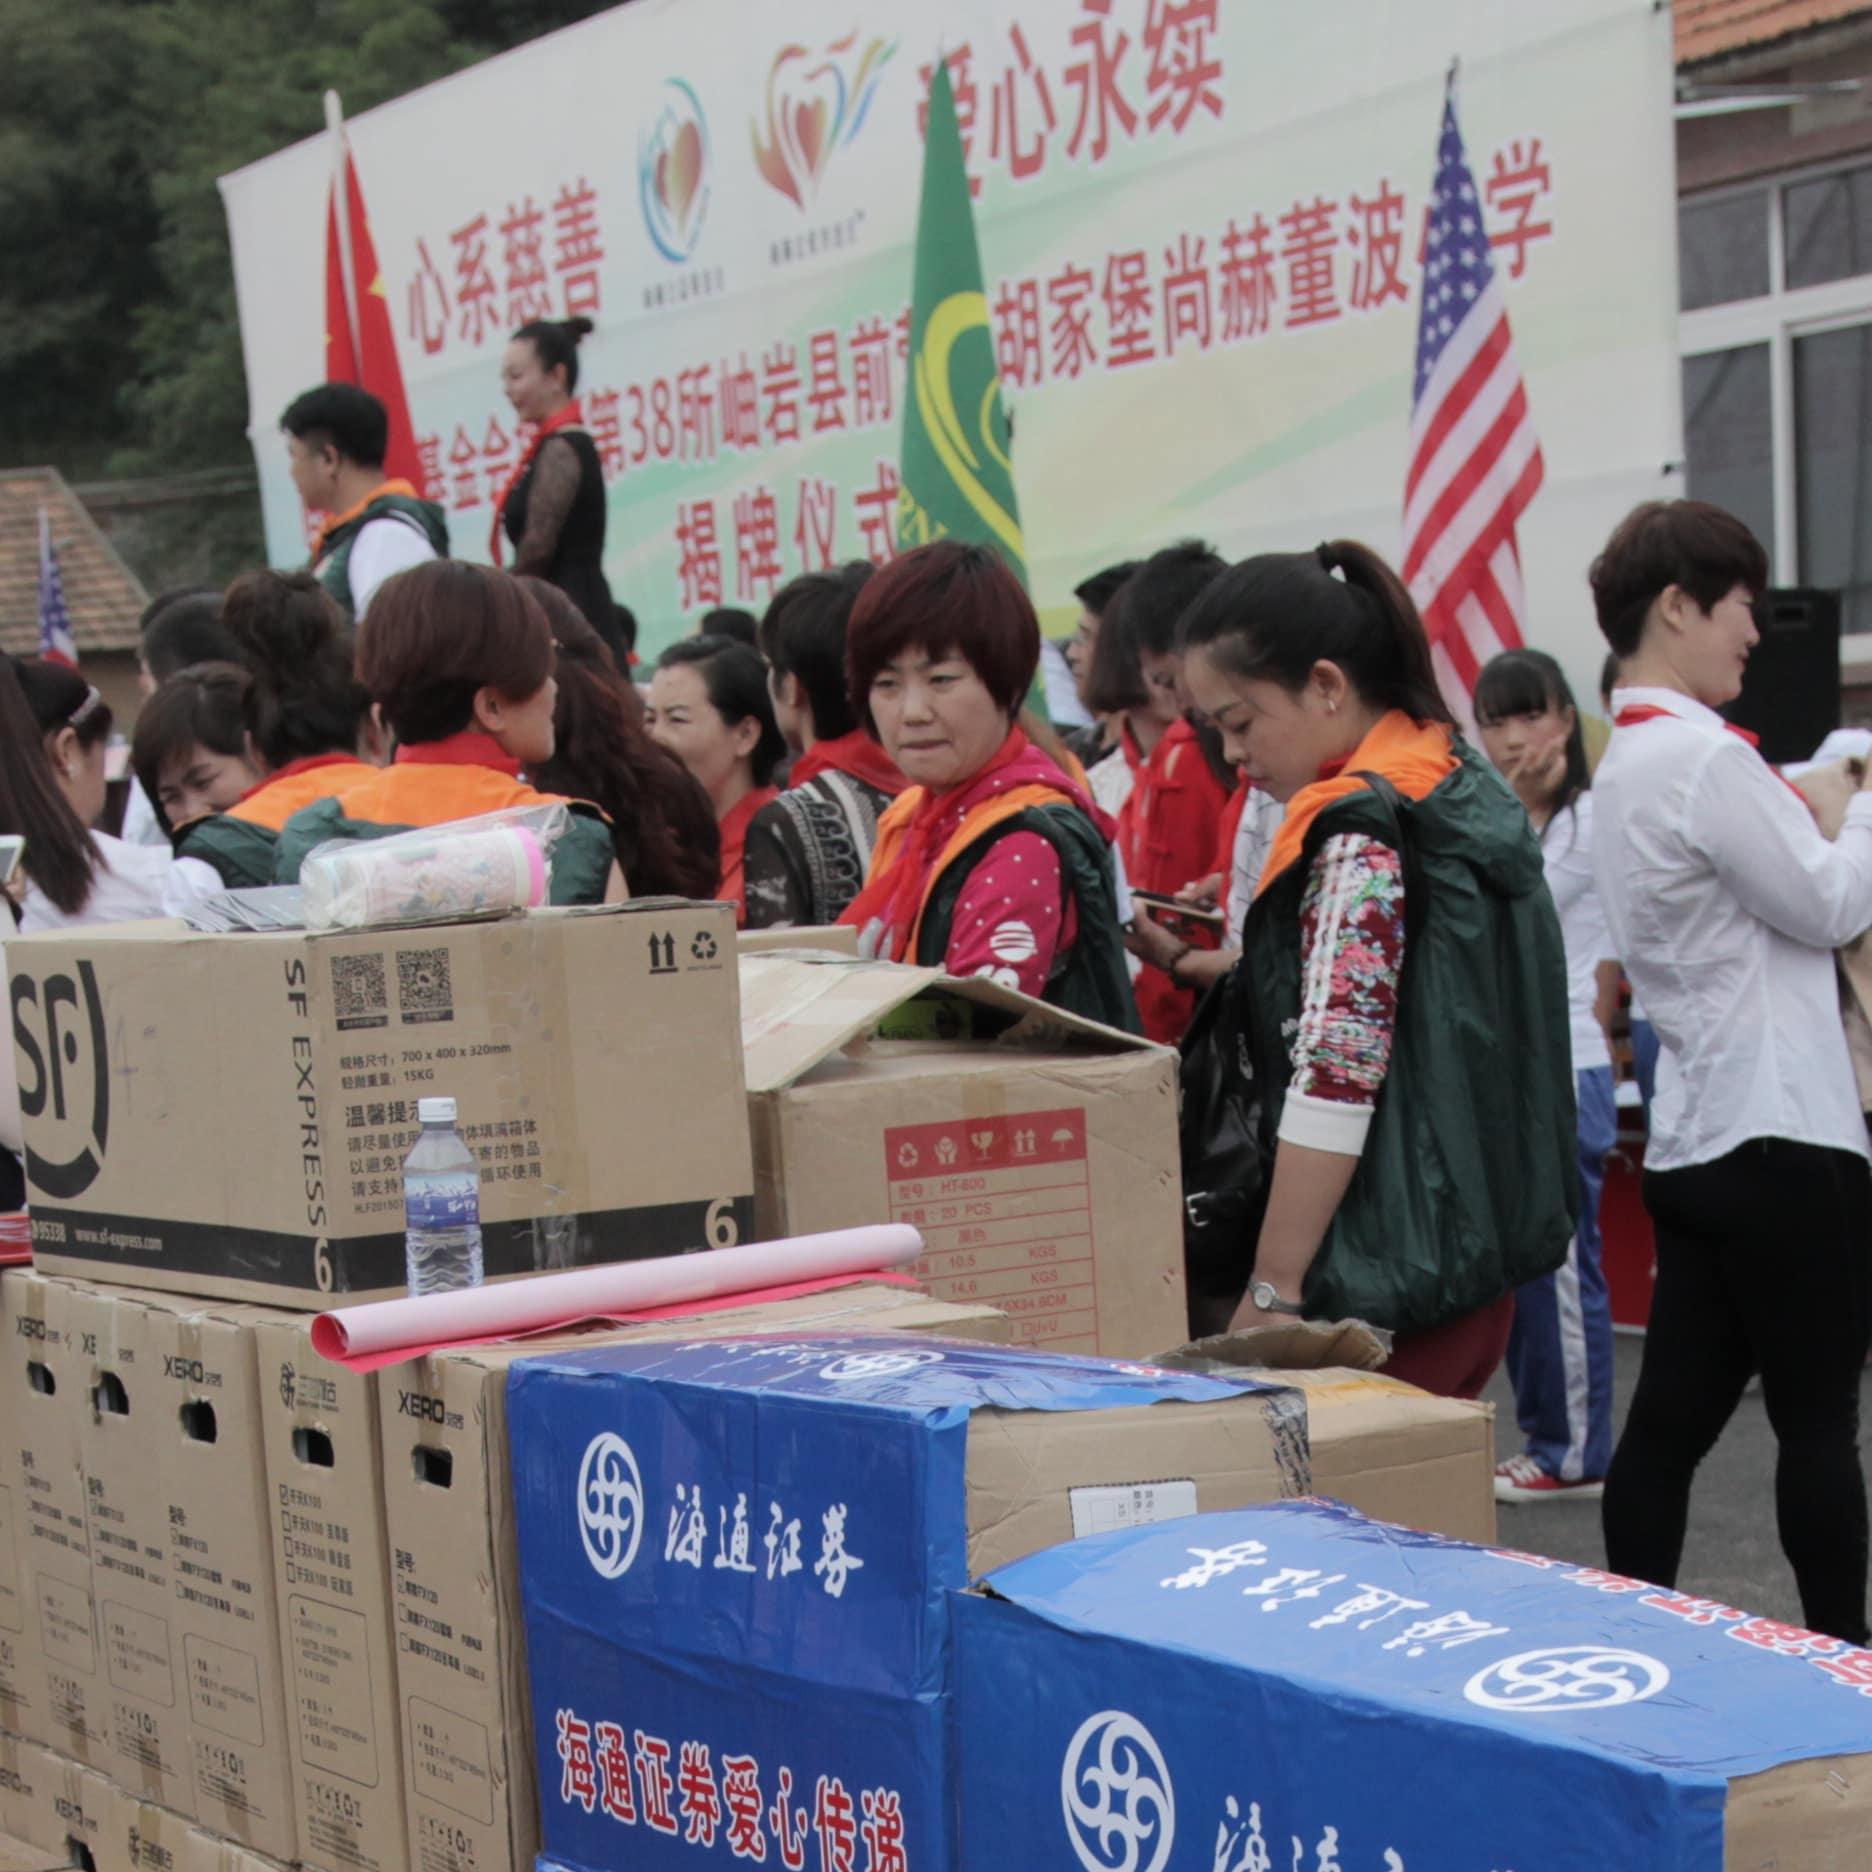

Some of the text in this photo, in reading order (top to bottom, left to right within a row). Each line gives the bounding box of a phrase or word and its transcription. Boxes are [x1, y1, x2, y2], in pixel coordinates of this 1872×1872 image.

[407, 178, 604, 356] 心系慈善
[675, 460, 900, 610] 揭牌仪式
[9, 971, 79, 1121] SF
[401, 1049, 424, 1064] 700
[436, 1046, 458, 1061] 400
[470, 1042, 513, 1058] 320mm
[404, 1069, 434, 1083] 15KG
[284, 957, 327, 1228] SF EXPRESS
[345, 1100, 421, 1128] 温馨提示
[964, 1201, 992, 1216] PCS
[74, 1227, 163, 1252] www.sf-express.com
[704, 1198, 739, 1251] 6
[1029, 1244, 1057, 1258] KGS
[1030, 1269, 1058, 1284] KGS
[164, 1354, 203, 1384] XERO
[398, 1389, 445, 1425] XERO
[663, 1482, 866, 1599] 海通证券
